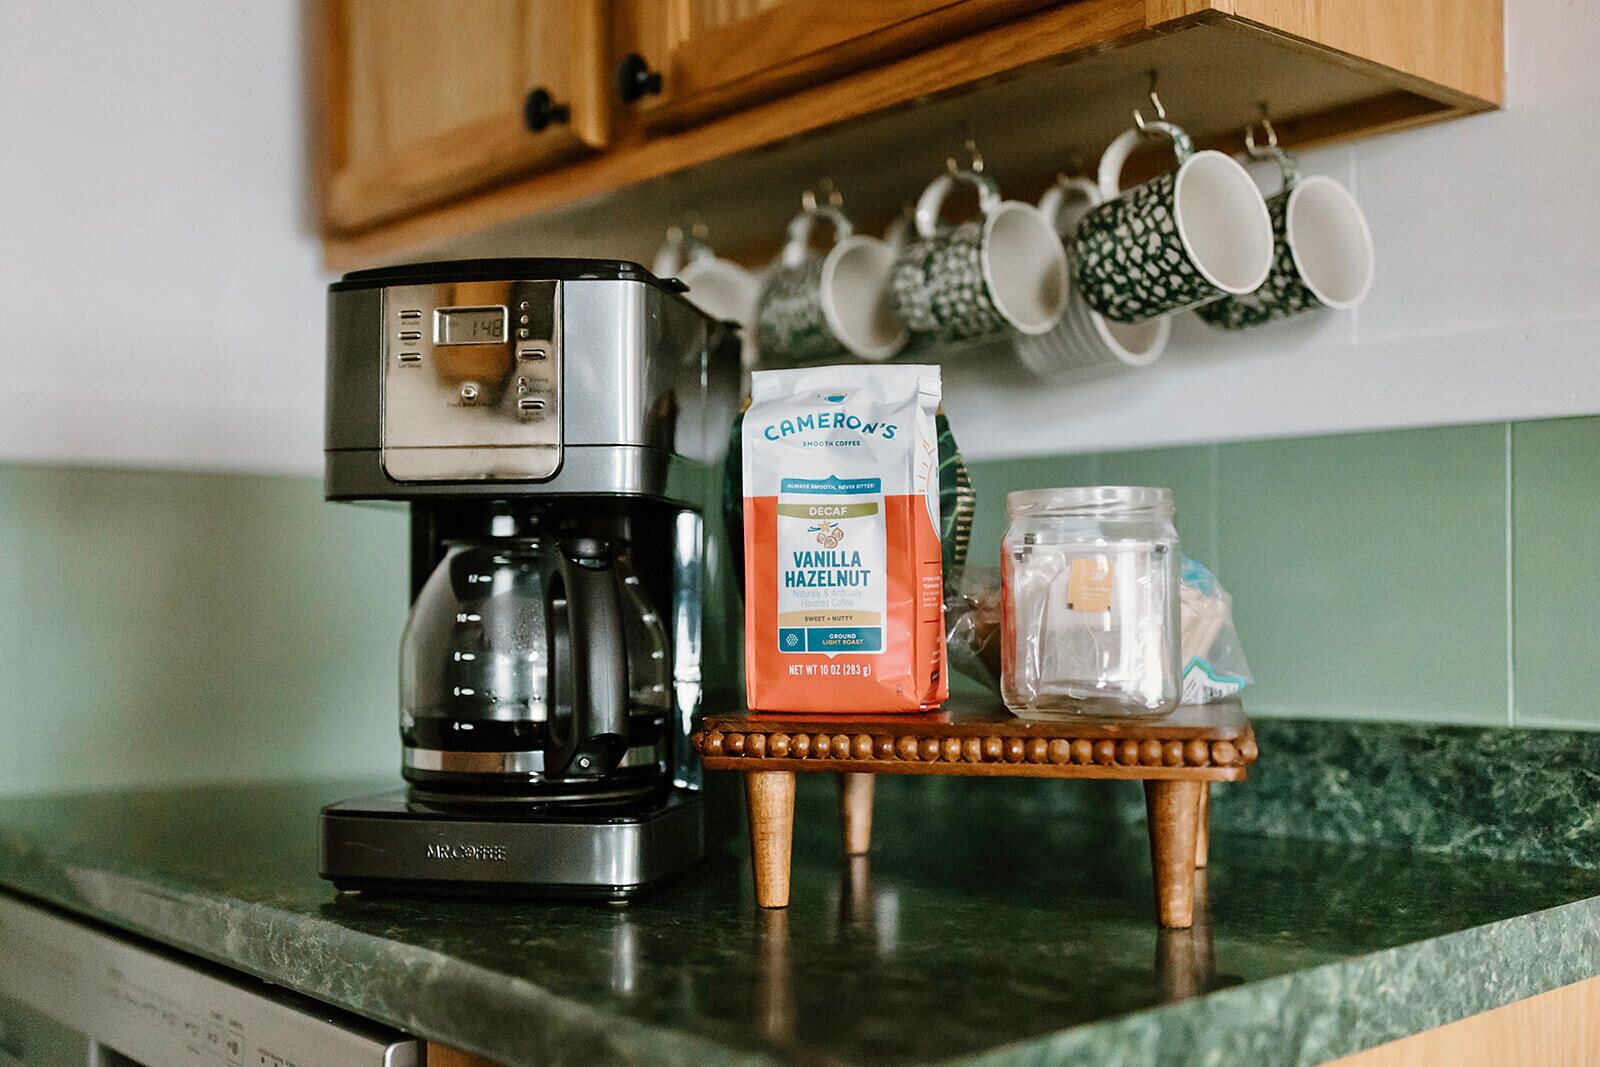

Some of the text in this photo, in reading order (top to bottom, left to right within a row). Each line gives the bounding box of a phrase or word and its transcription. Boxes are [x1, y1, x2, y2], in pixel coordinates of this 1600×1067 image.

[763, 412, 898, 441] CAMERON'S
[809, 506, 848, 516] DECAF
[793, 551, 862, 568] VANILLA
[785, 570, 871, 588] HAZELNUT
[456, 613, 467, 623] 10
[788, 663, 872, 678] NET WT 10 OZ (283 g)
